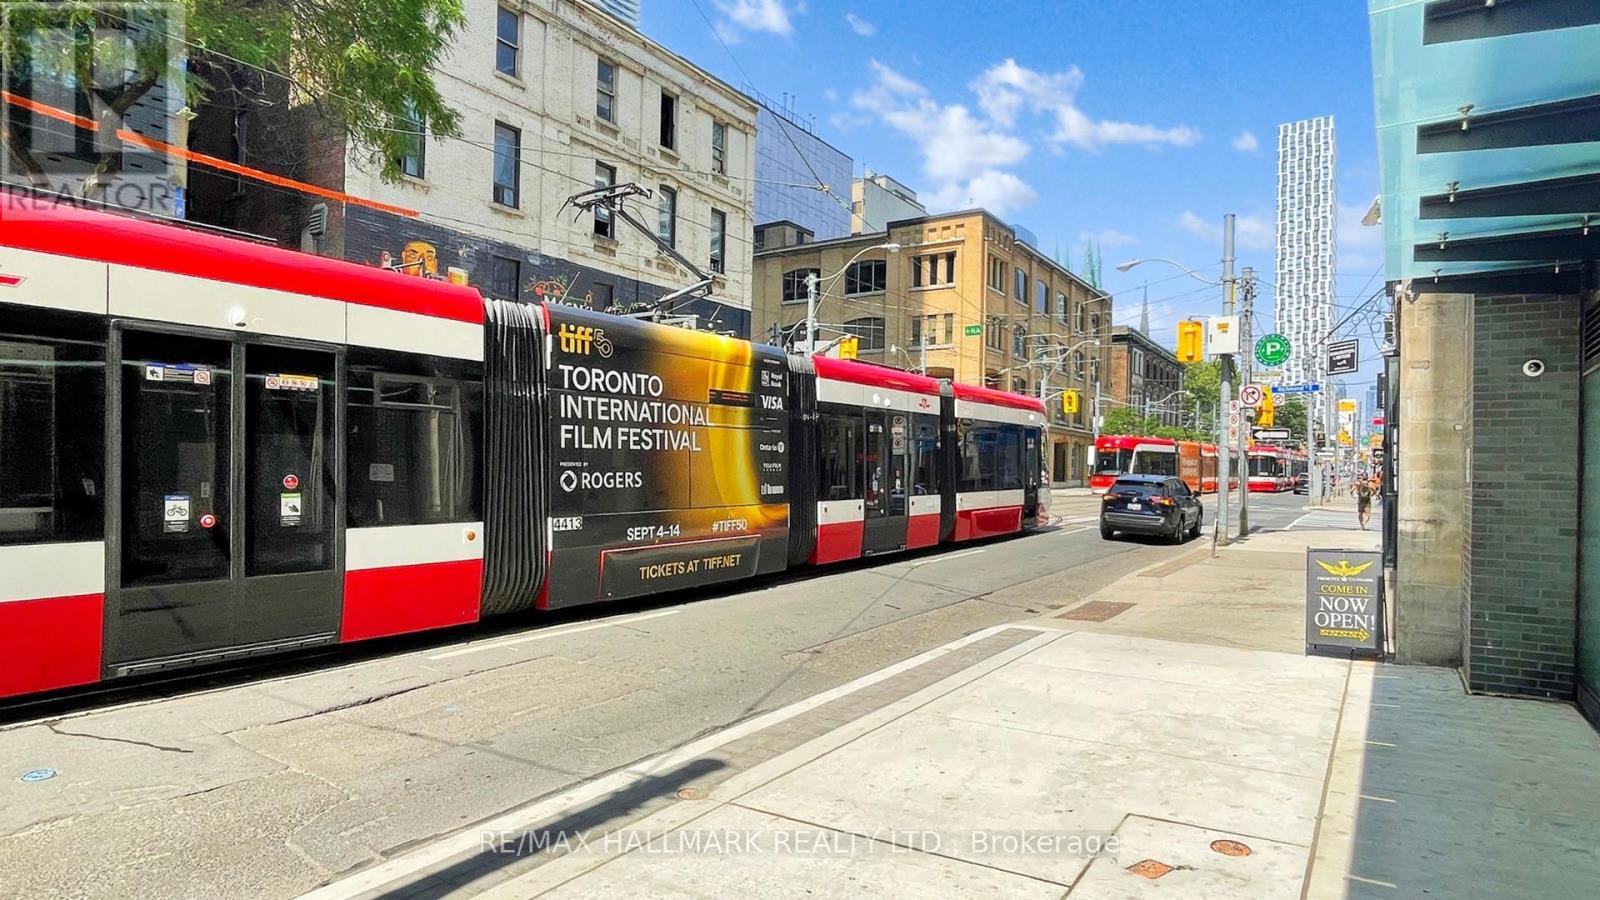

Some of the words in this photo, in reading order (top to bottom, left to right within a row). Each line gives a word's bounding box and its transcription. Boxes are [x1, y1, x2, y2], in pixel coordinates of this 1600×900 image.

[559, 323, 593, 355] tiff
[1266, 342, 1280, 355] P
[558, 364, 663, 397] TORONTO
[560, 394, 715, 426] INTERNATIONAL
[760, 395, 783, 410] VISA
[560, 425, 612, 449] FILM
[618, 427, 702, 451] FESTIVAL
[581, 471, 643, 489] ROGERS
[554, 517, 582, 531] 4413
[627, 525, 656, 540] SEPT
[712, 520, 748, 533] #TIFF50
[639, 562, 685, 579] TICKETS
[686, 560, 700, 573] AT
[703, 554, 741, 571] TIFF.NET
[1320, 584, 1353, 593] COME
[1355, 585, 1368, 594] IN
[1319, 596, 1369, 613] NOW
[1314, 612, 1375, 630] OPEN!
